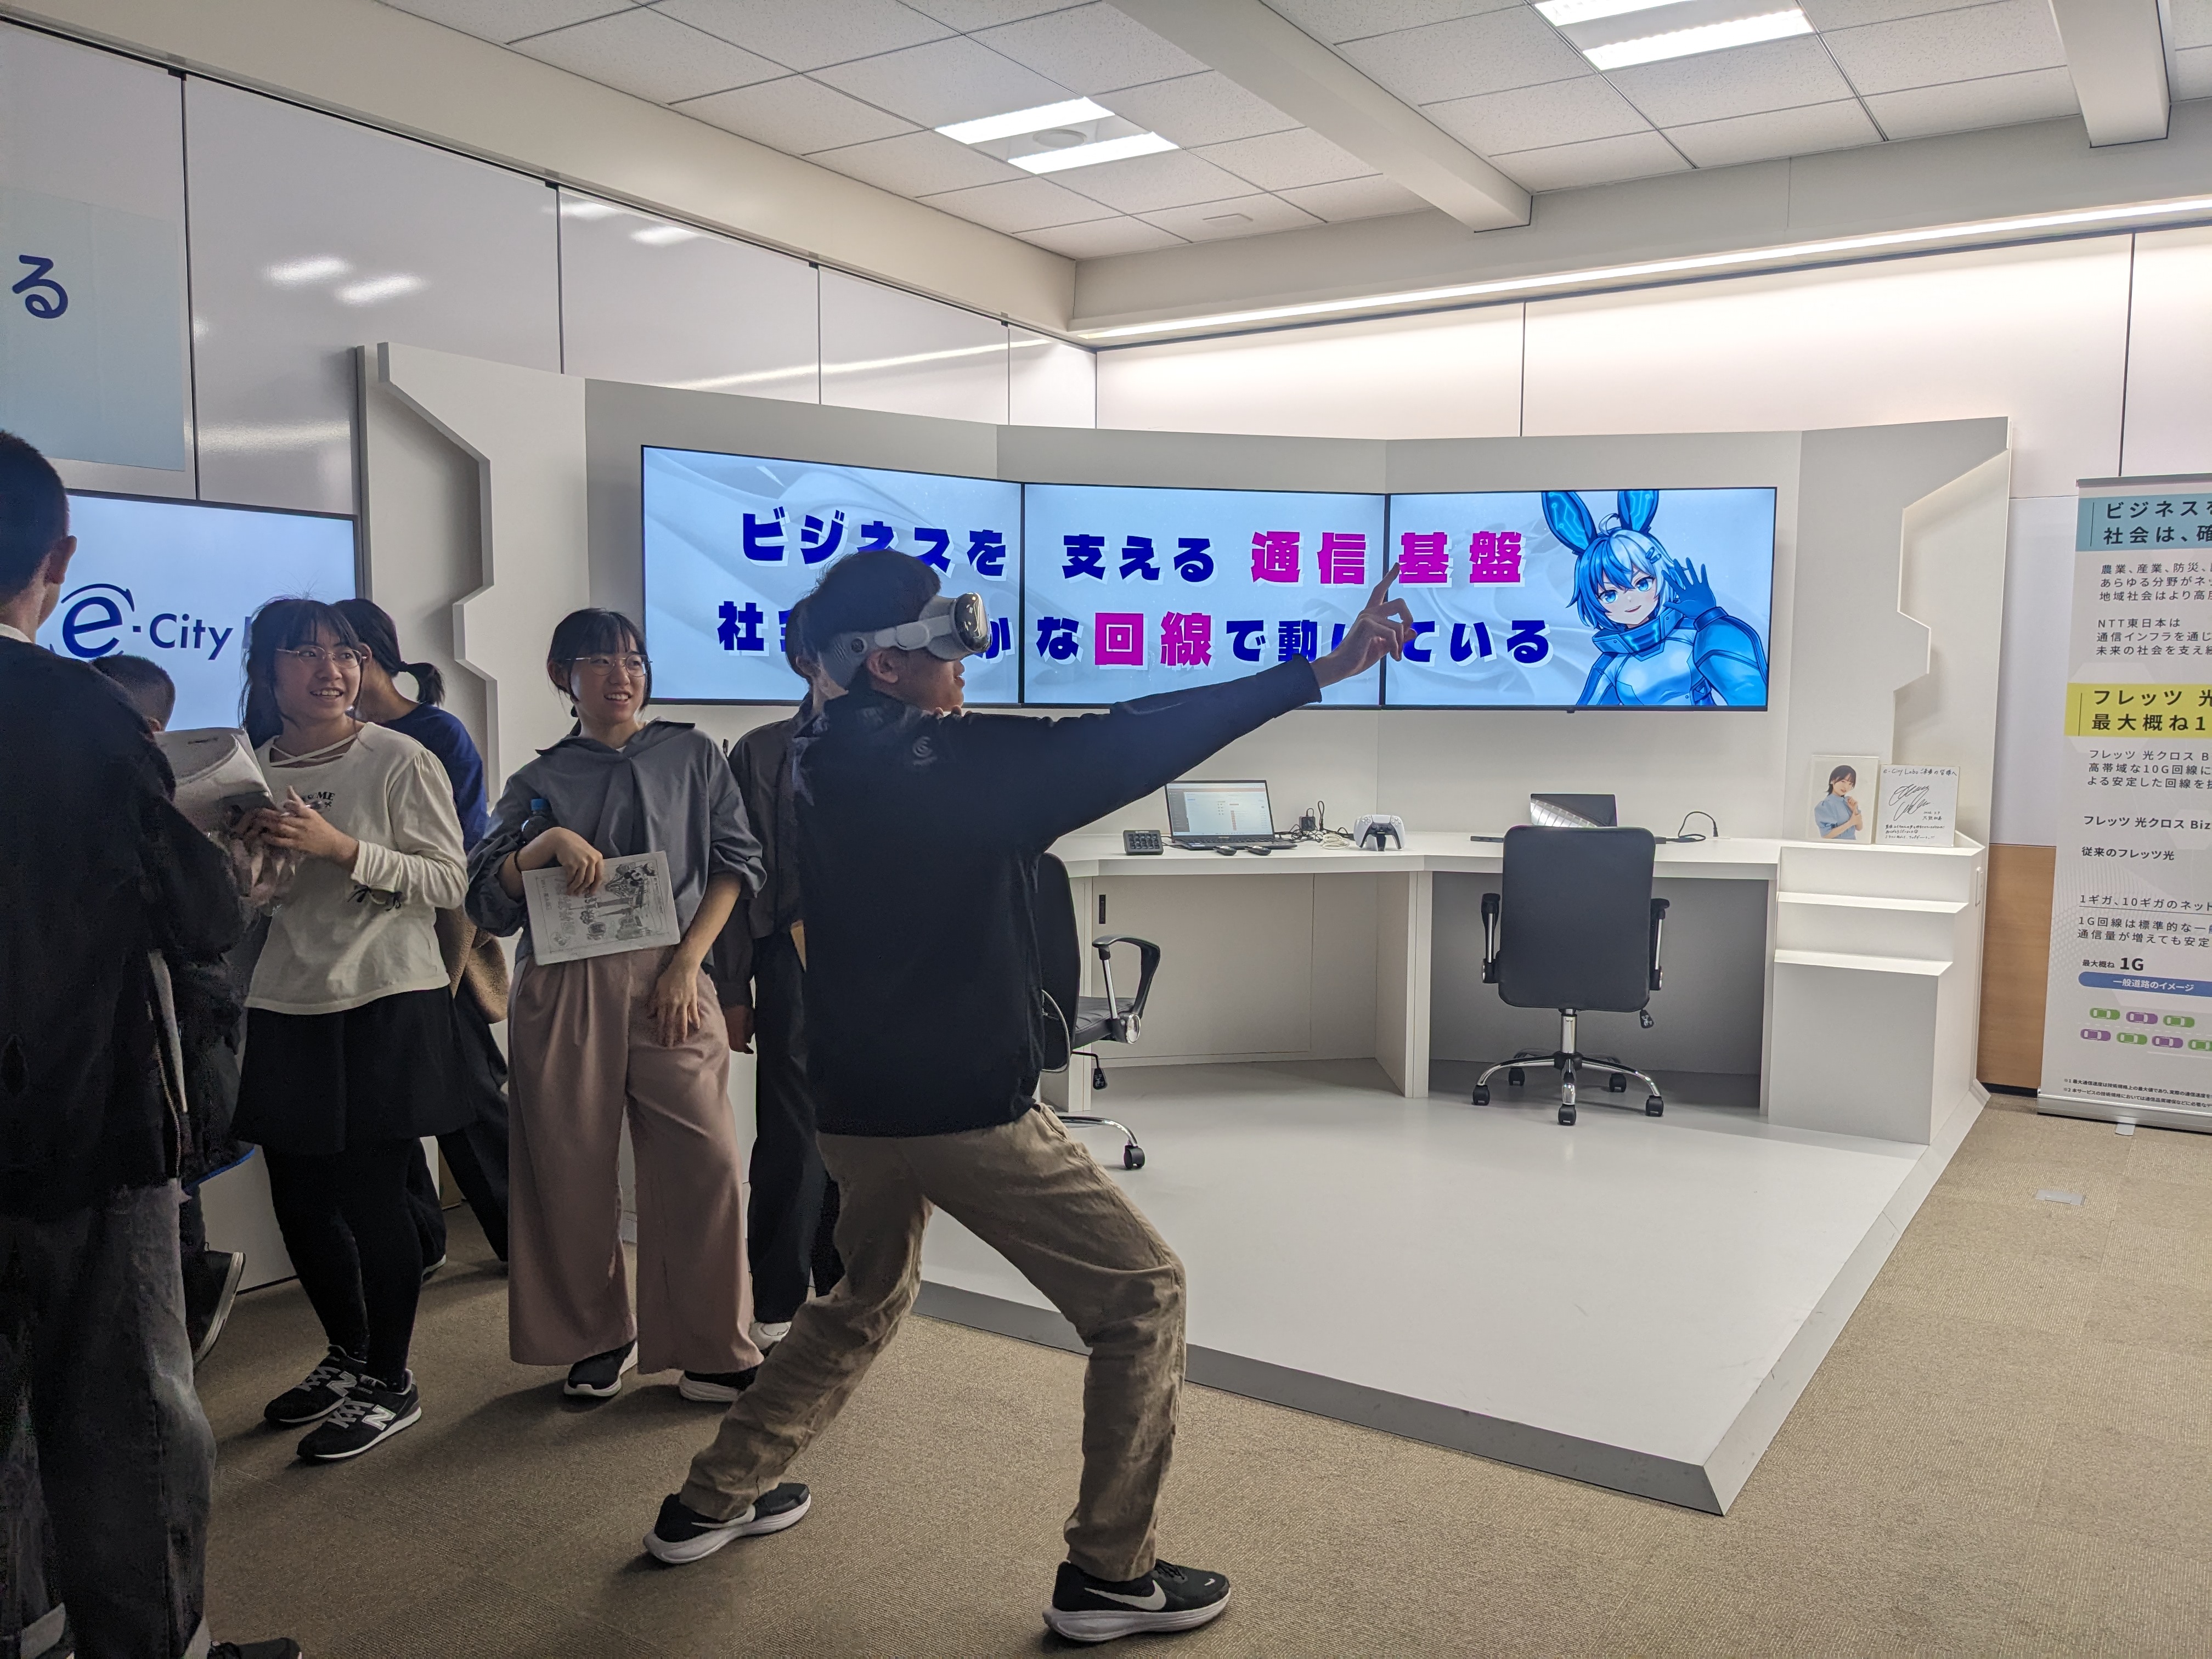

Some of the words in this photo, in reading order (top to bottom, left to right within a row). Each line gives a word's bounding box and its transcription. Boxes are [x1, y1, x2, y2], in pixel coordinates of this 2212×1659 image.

[12, 255, 68, 319] る
[742, 506, 1006, 577] ビジネスを
[1062, 534, 1215, 583] 支える
[2101, 562, 2212, 574] 農業、産業、防災、
[2097, 618, 2181, 629] NTT東日本は
[2094, 690, 2182, 706] フレッツ
[2090, 750, 2135, 760] フレッツ
[2142, 751, 2193, 761] 光クロス
[2084, 816, 2130, 826] フレッツ
[2135, 817, 2185, 829] 光クロス
[2191, 820, 2211, 830] Biz
[2081, 847, 2175, 861] 従来のフレッツ光
[2082, 959, 2115, 969] 最大概ね
[2120, 957, 2144, 972] 1G
[2113, 978, 2194, 992] 一般道路のイメージ
